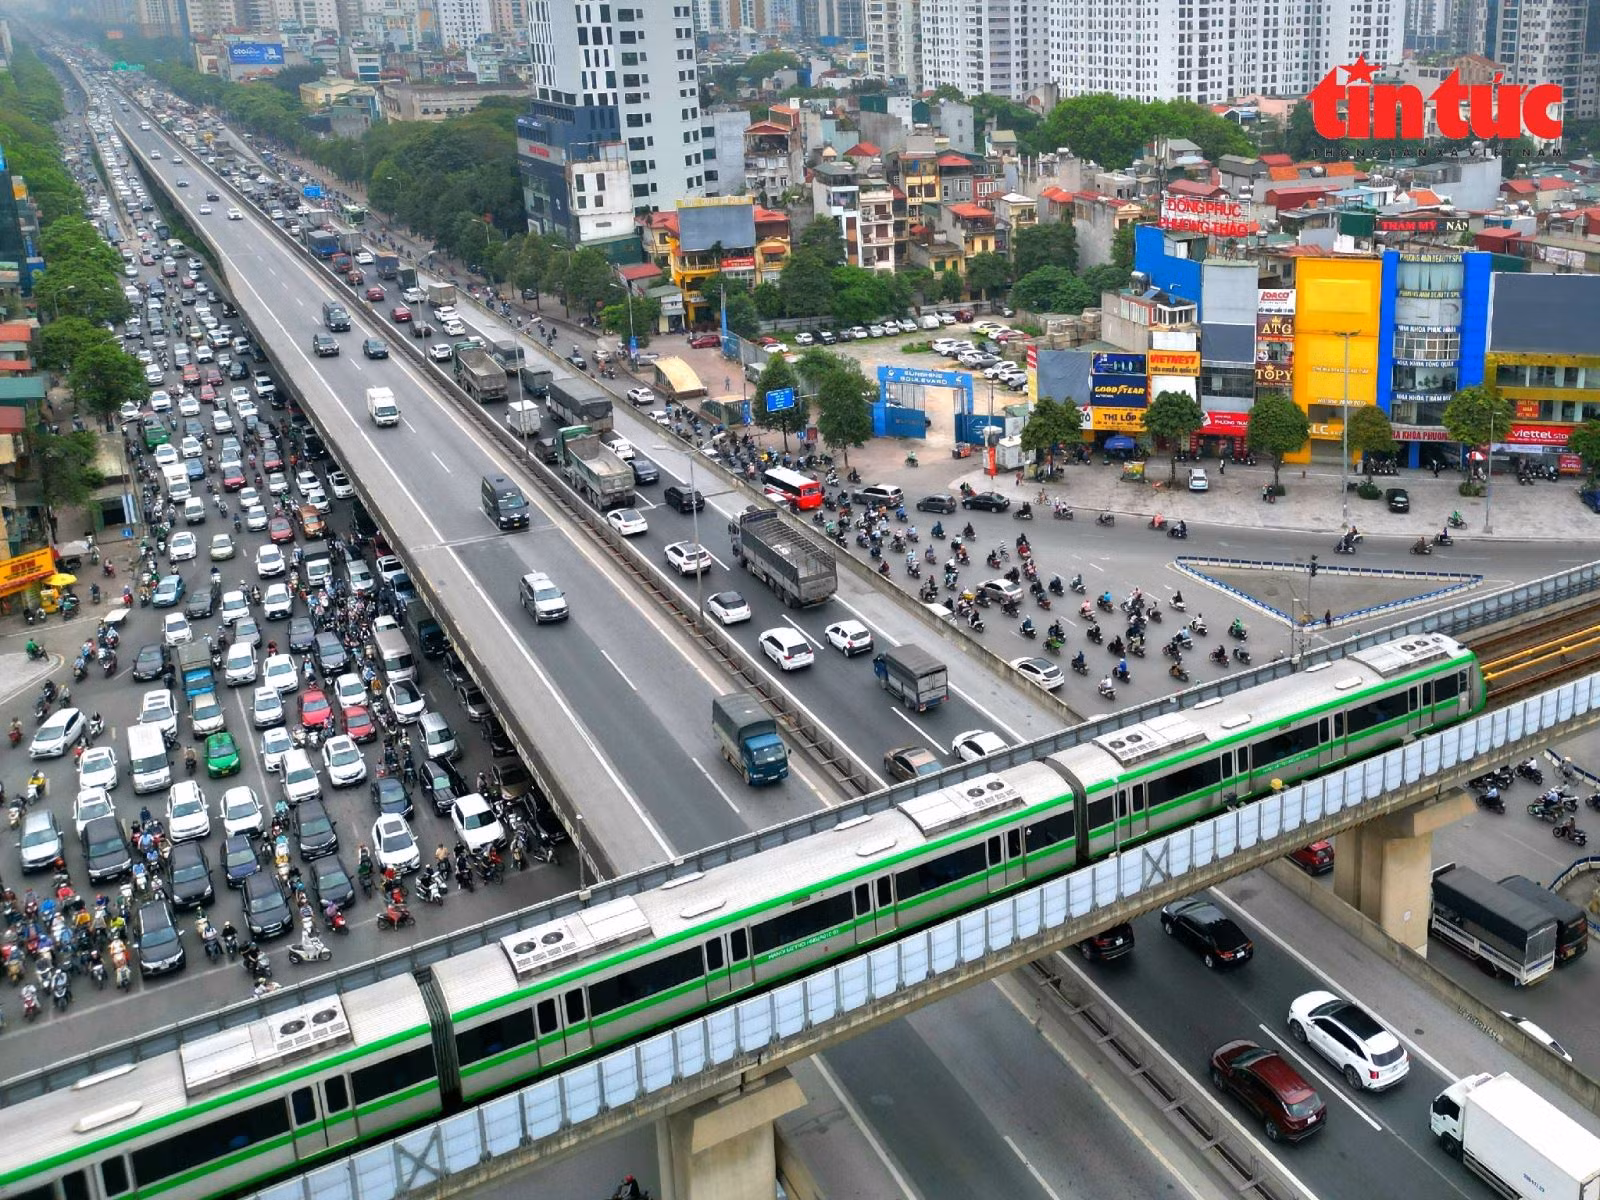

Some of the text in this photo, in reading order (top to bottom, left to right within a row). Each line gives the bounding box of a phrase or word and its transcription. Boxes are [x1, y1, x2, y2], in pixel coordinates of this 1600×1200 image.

[1261, 323, 1292, 334] ATG
[900, 376, 948, 385] BOULEVARD
[1255, 370, 1293, 381] TOPY
